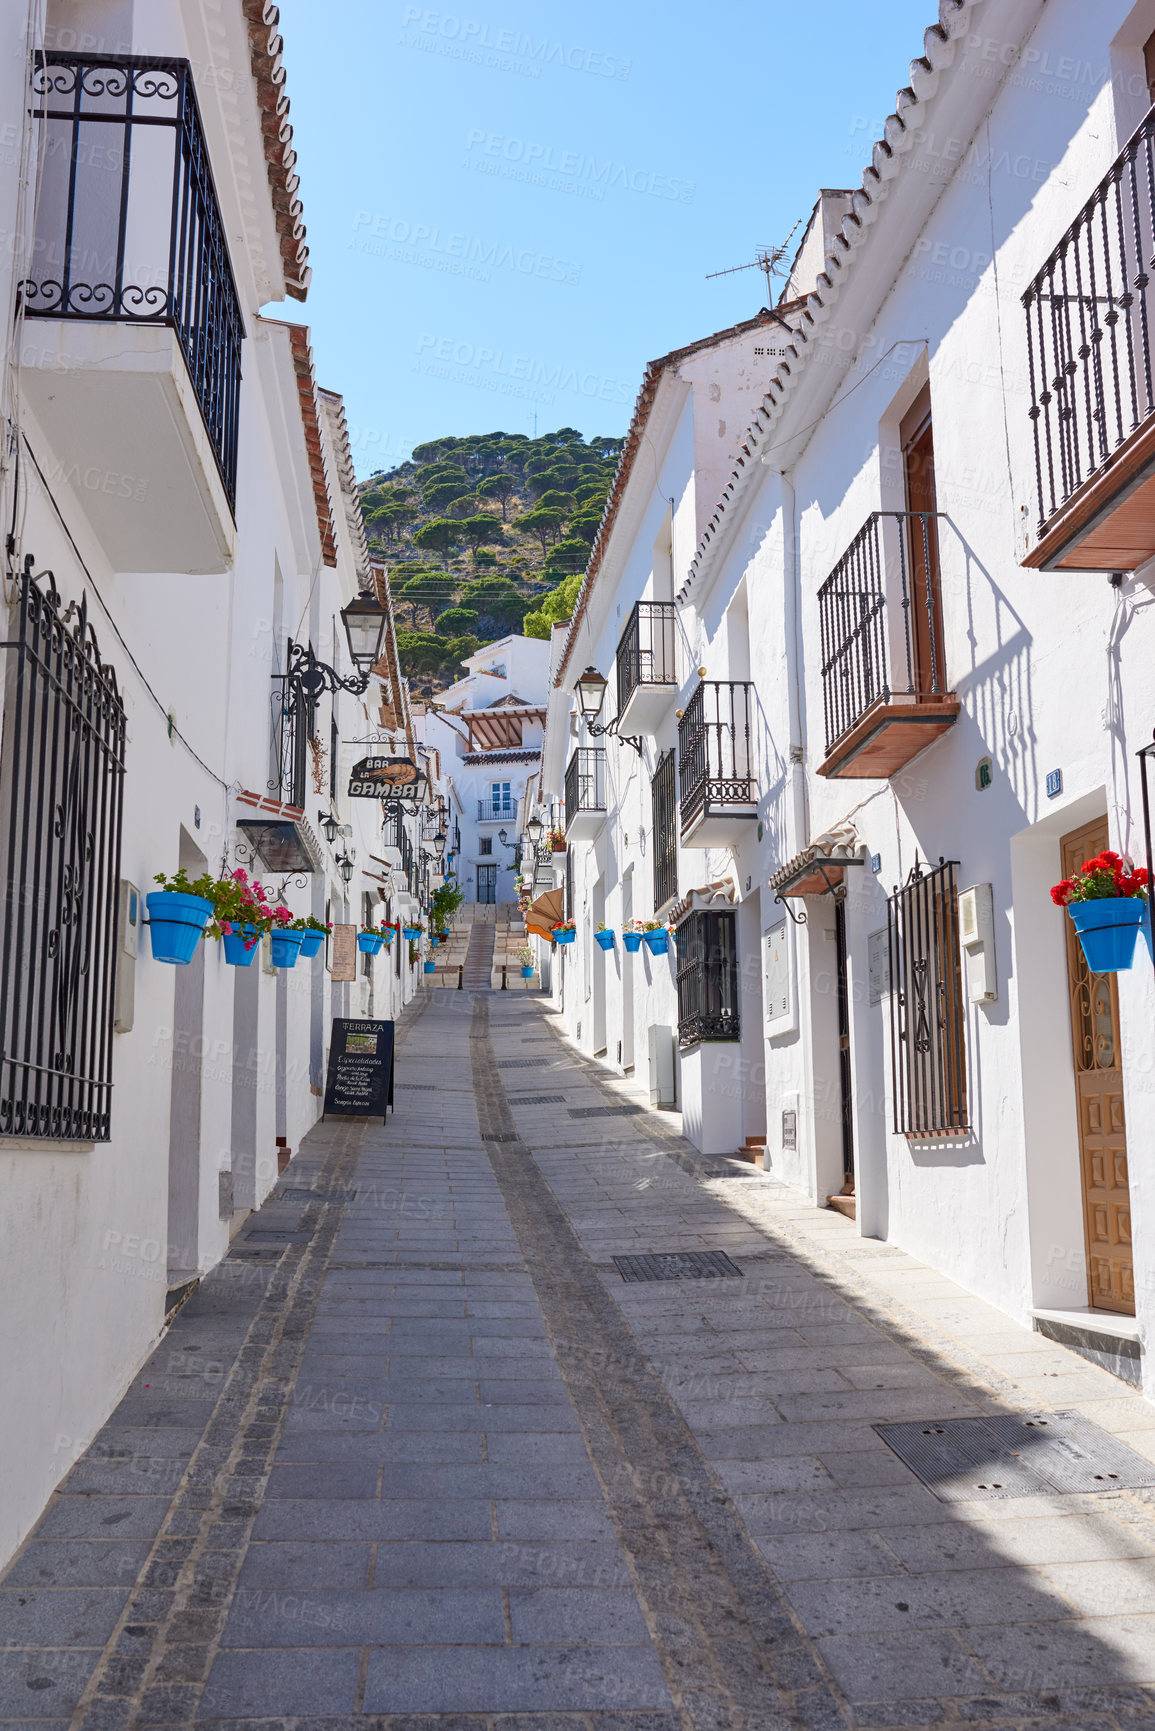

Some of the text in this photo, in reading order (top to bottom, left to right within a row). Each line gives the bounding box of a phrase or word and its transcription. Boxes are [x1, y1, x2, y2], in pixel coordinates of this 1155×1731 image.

[366, 760, 389, 769] BAR
[350, 781, 415, 798] GAMBA
[1047, 772, 1059, 794] 18
[342, 1022, 384, 1032] TERRAZA
